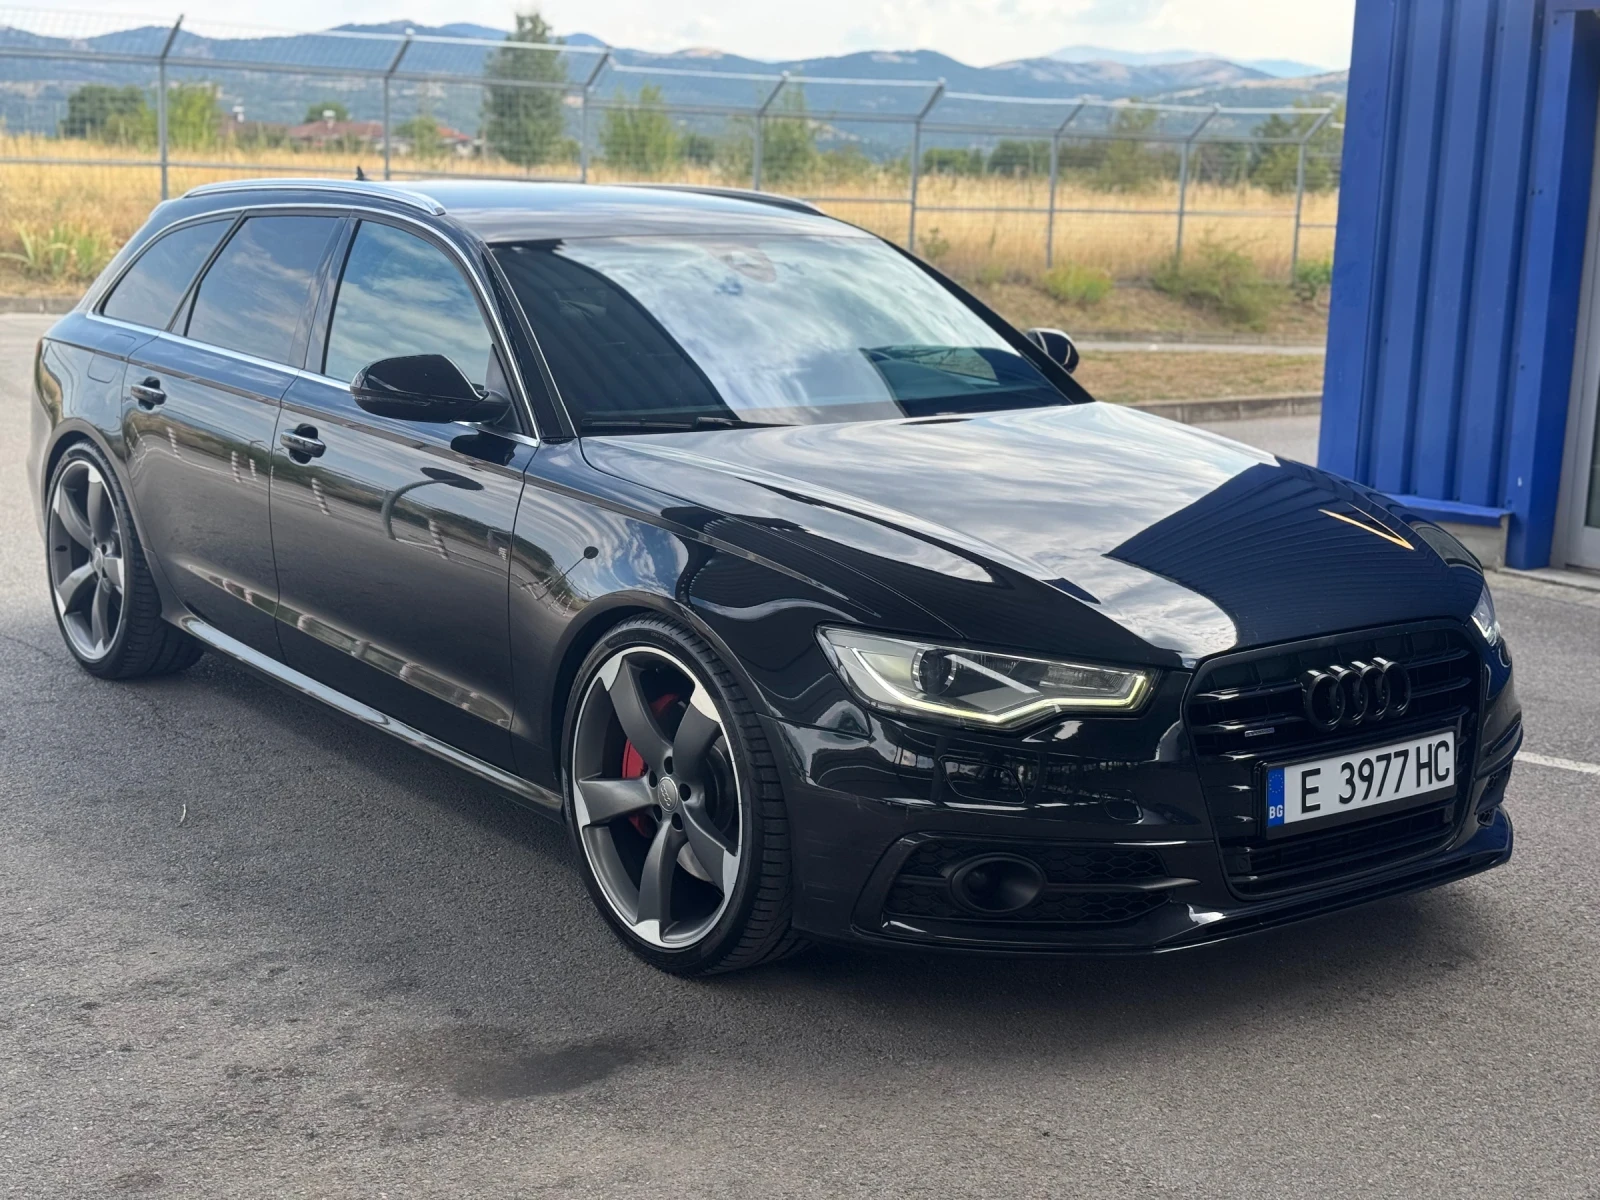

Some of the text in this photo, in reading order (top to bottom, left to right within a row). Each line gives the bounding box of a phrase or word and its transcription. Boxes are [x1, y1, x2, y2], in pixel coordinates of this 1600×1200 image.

[1301, 740, 1450, 814] E 3977 HC
[1269, 804, 1284, 819] BG
